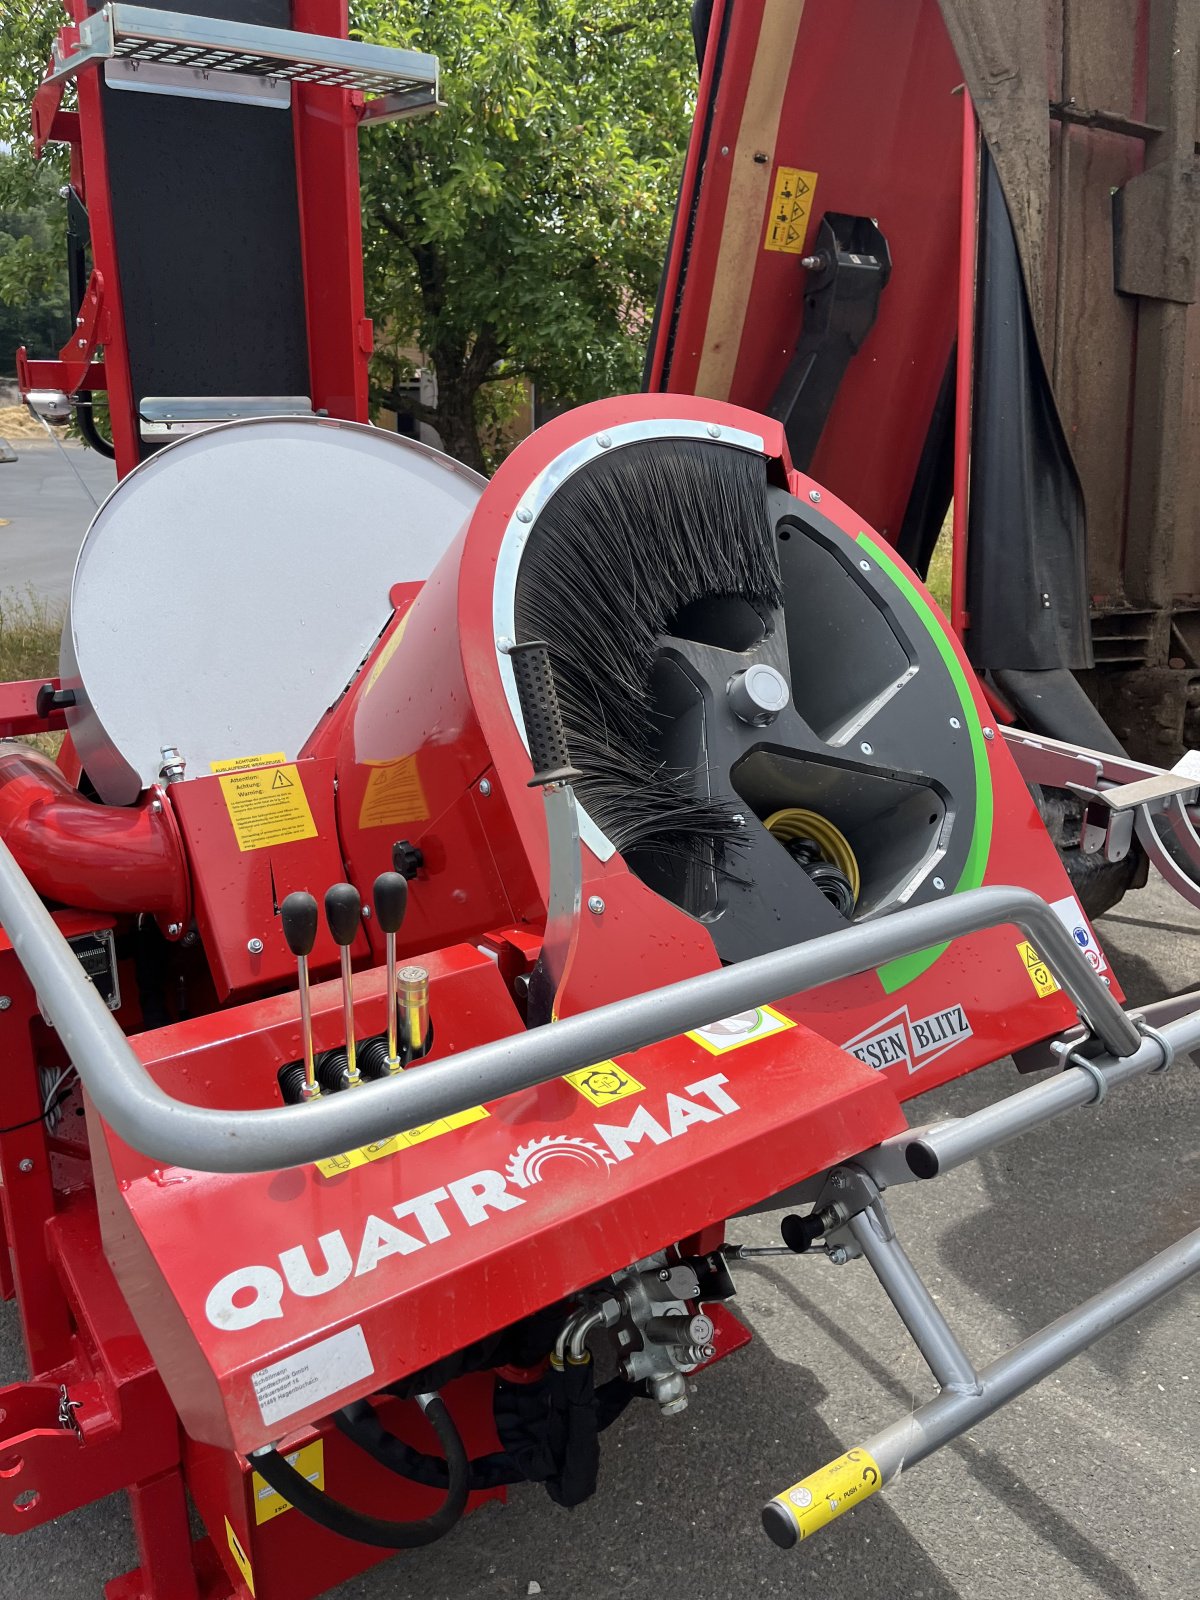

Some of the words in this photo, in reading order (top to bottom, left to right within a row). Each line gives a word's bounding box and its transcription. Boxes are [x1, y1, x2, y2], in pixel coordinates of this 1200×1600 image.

[1040, 984, 1053, 994] STOP
[911, 1007, 969, 1049] BLITZ
[292, 1365, 309, 1376] GmbH
[844, 1486, 857, 1499] PUSH
